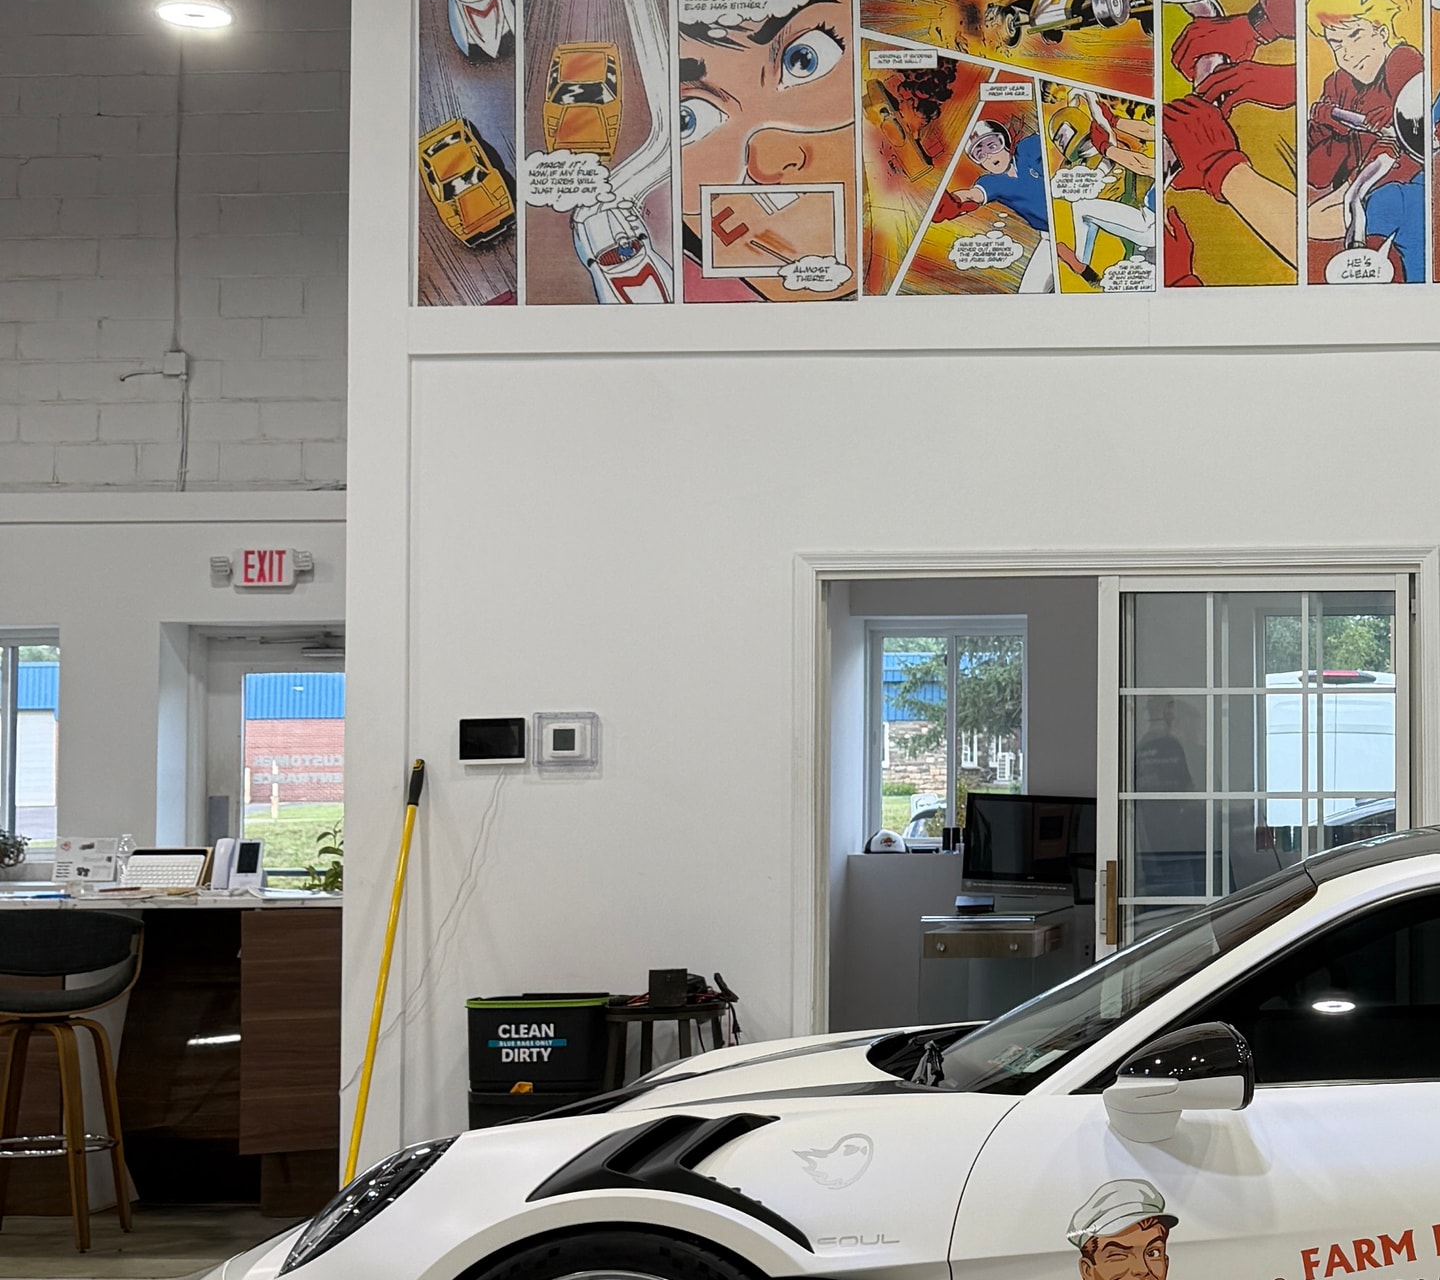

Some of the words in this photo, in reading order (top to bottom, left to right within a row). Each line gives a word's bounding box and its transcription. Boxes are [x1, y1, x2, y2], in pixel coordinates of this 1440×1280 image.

[536, 160, 566, 170] MADE
[530, 186, 554, 194] JUST
[793, 264, 830, 274] ALMOST
[1347, 256, 1372, 268] HE'S
[1341, 266, 1381, 280] CLEAR!
[244, 550, 286, 582] EXIT
[498, 1024, 554, 1038] CLEAN
[501, 1048, 552, 1062] DIRTY
[817, 1234, 900, 1249] SOUL
